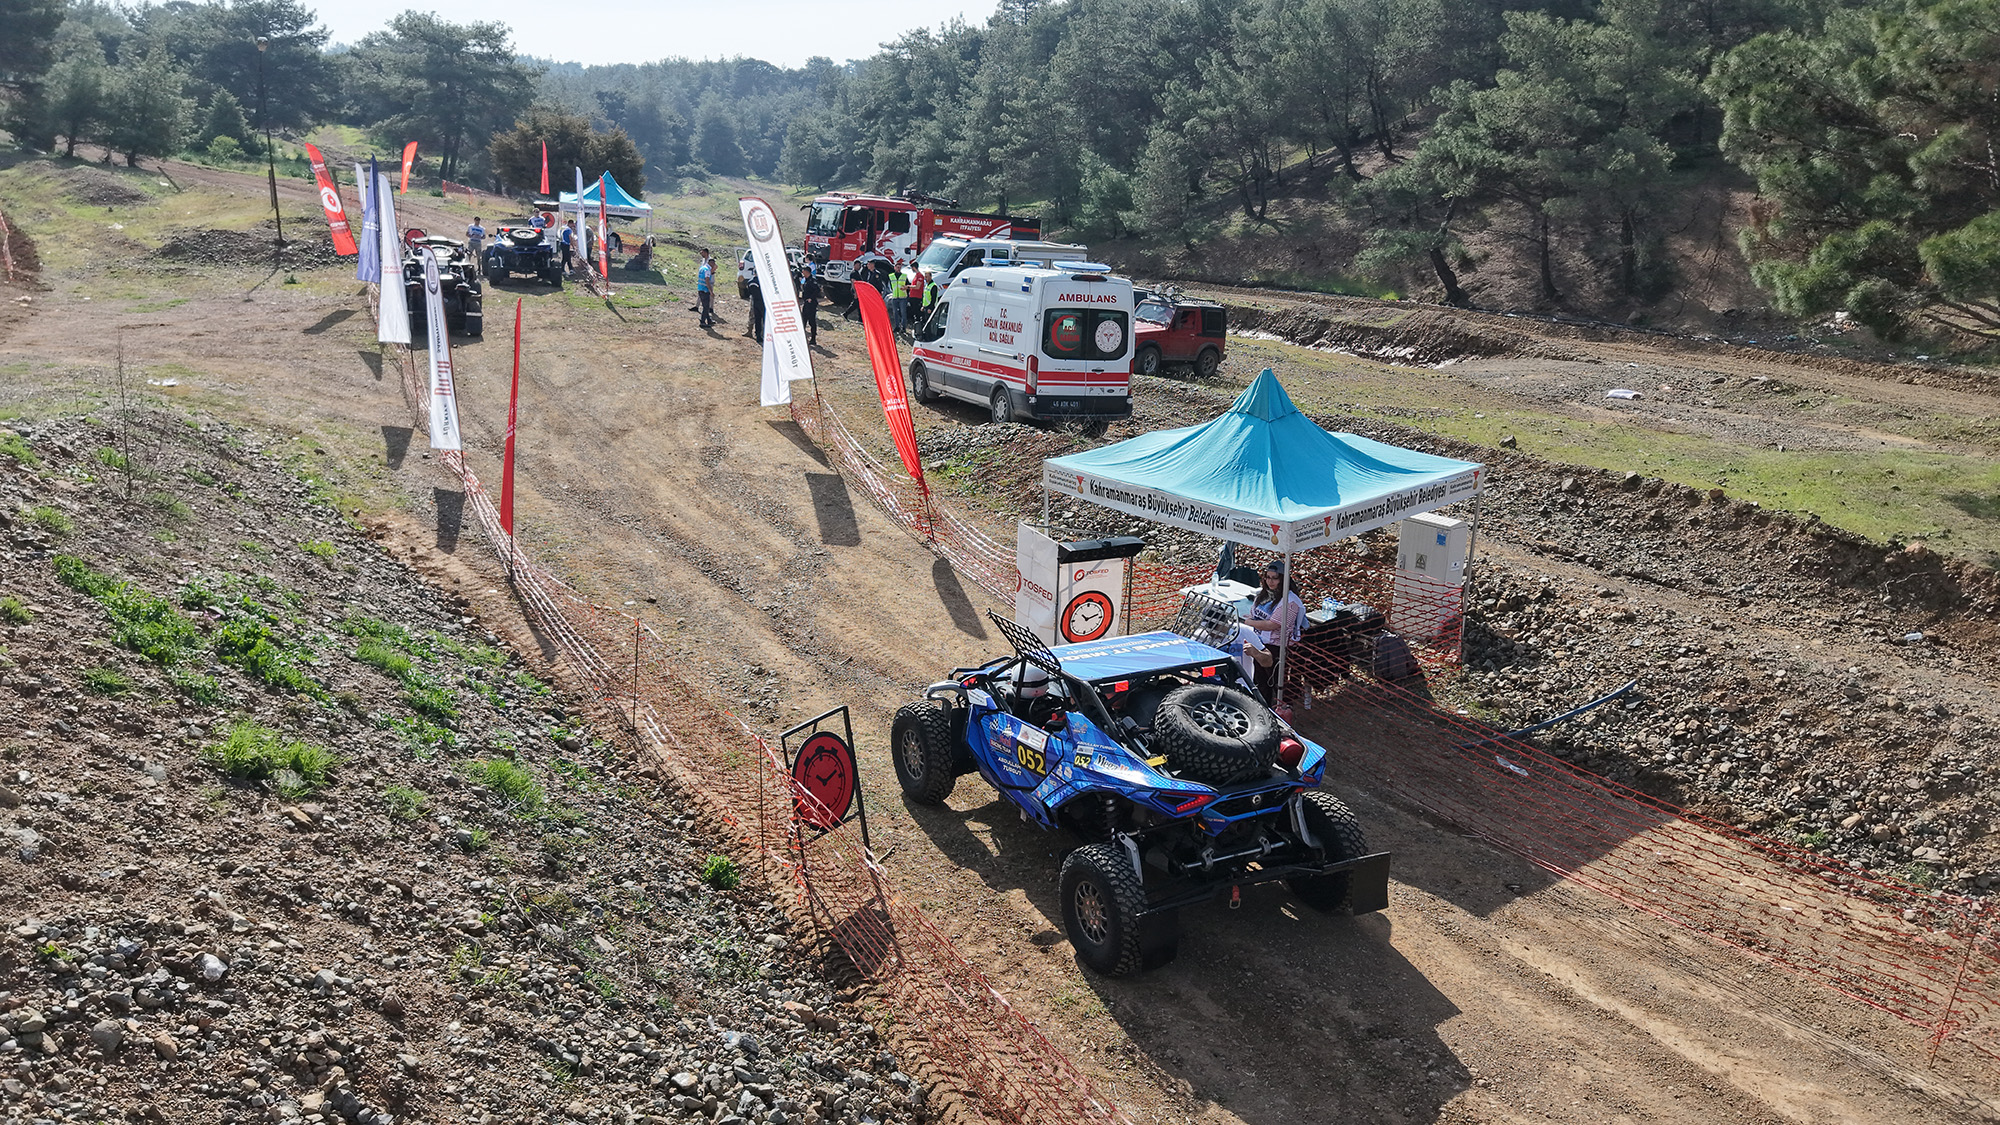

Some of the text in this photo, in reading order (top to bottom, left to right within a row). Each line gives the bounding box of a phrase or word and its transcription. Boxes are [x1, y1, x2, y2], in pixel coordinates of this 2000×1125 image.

[1058, 293, 1117, 303] AMBULANS
[984, 316, 998, 329] SAĞLIK
[999, 333, 1015, 345] SAĞLIK
[1089, 479, 1147, 511] Kahramanmaraş
[1147, 493, 1188, 520] Büyükşehir
[1188, 505, 1230, 531] Belediyesi
[1336, 480, 1448, 531] Kahramanmaraş Büyükşehir Belediyesi
[1023, 578, 1053, 601] TOSFED
[1017, 745, 1046, 775] 052
[1074, 755, 1091, 768] 052
